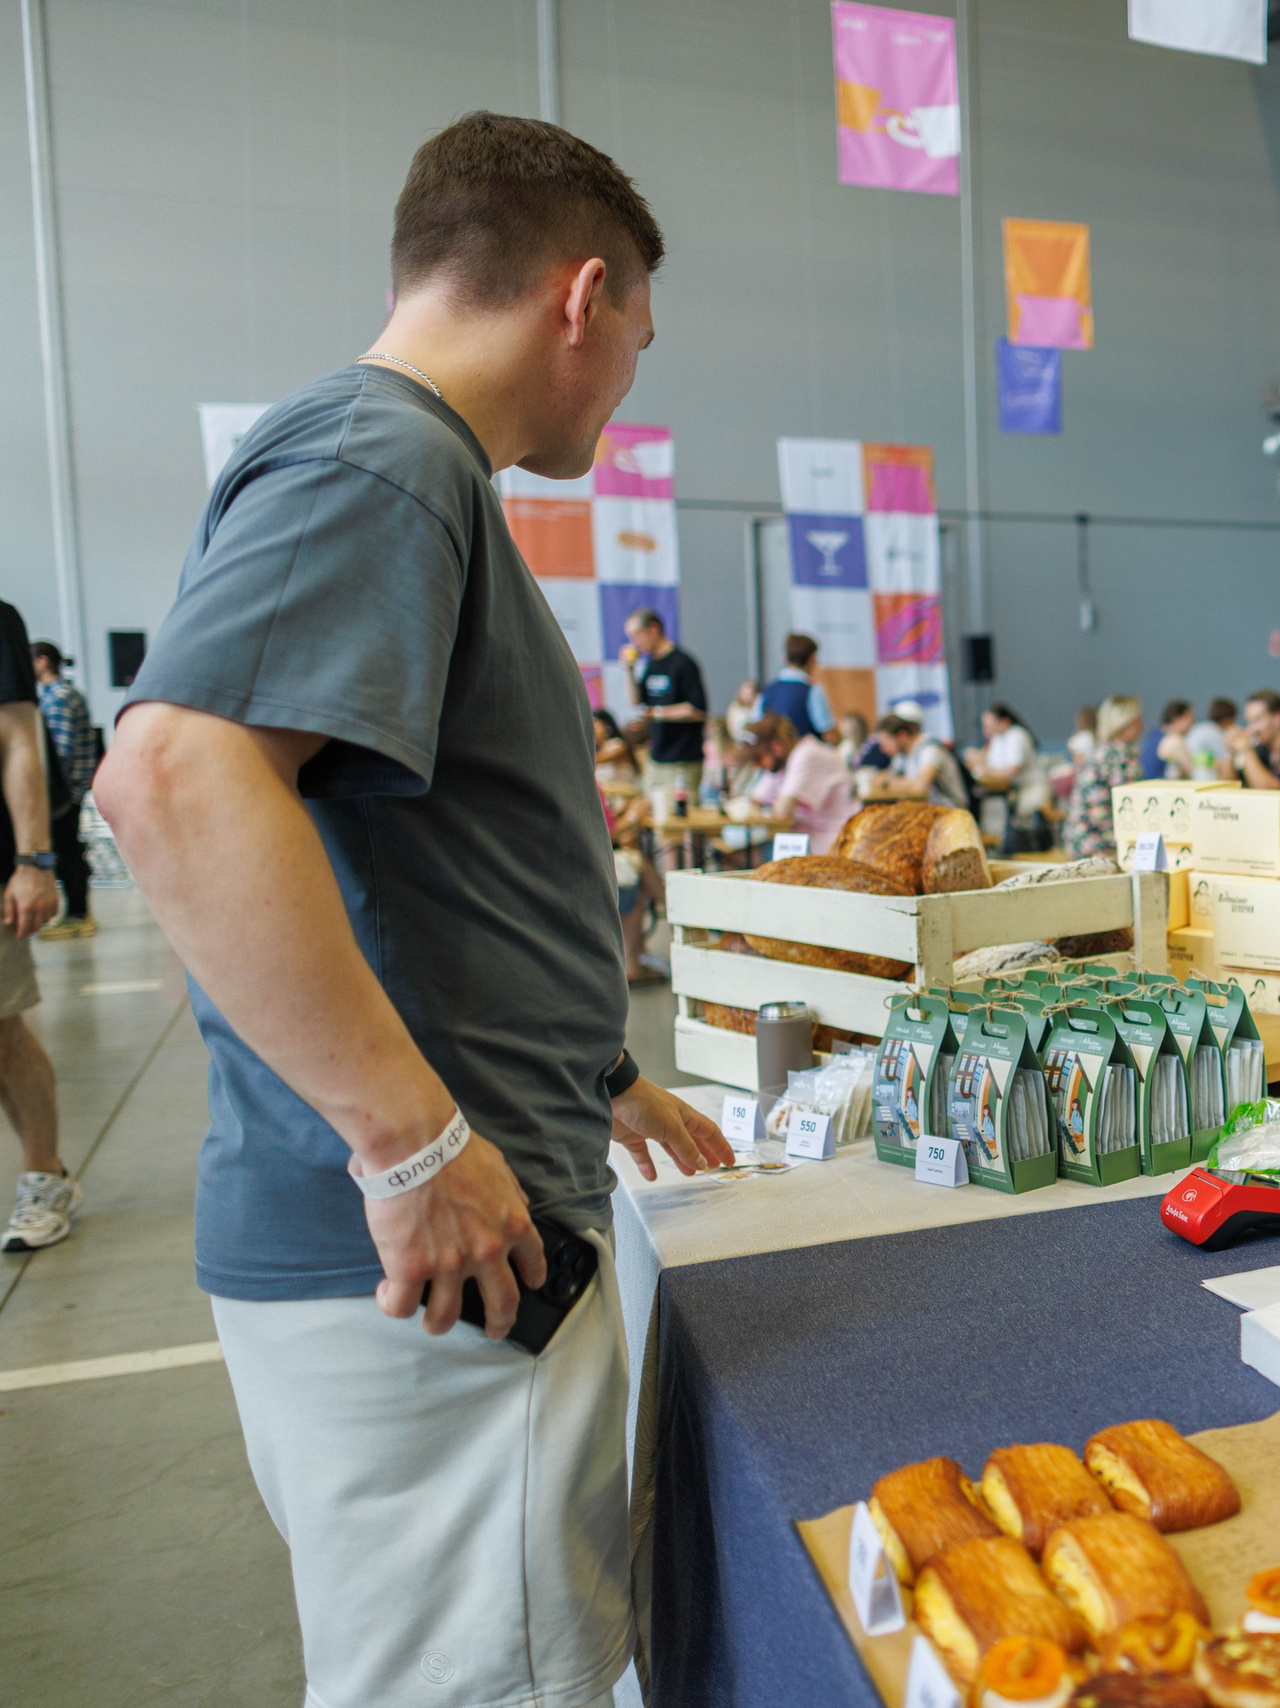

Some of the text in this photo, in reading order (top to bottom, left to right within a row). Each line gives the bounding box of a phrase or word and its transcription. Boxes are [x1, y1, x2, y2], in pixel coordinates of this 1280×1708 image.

[731, 1105, 746, 1119] 150
[800, 1119, 817, 1133] 550
[928, 1146, 945, 1161] 750
[388, 1145, 444, 1187] флоу
